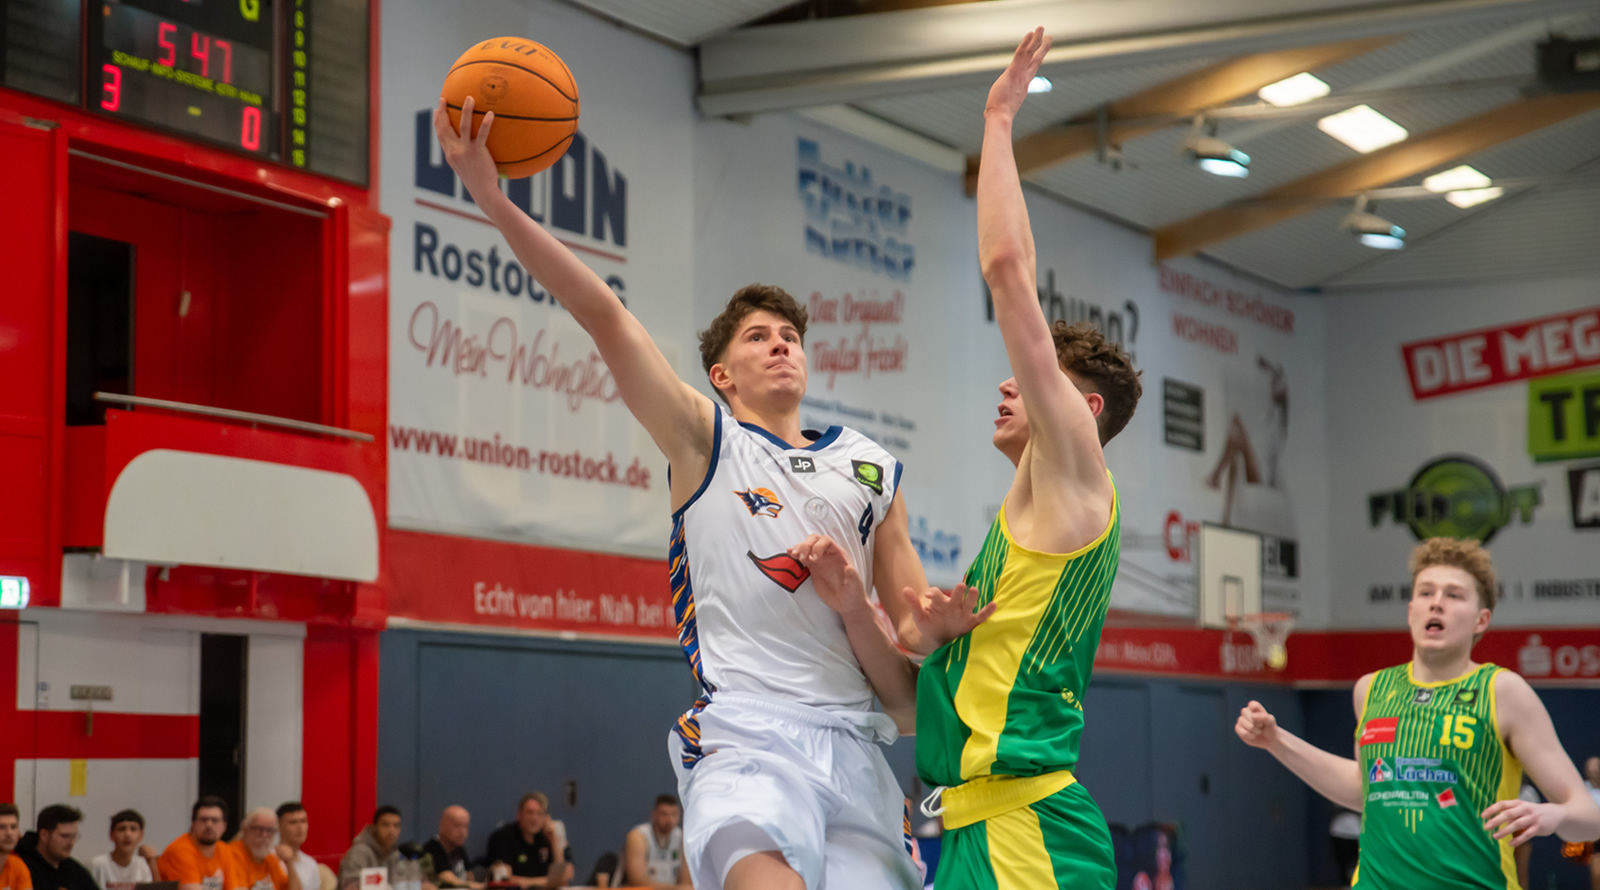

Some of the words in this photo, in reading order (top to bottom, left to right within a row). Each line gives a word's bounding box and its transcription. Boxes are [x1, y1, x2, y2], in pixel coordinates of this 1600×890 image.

[158, 22, 177, 67] 5
[191, 33, 232, 84] 47
[101, 63, 122, 112] 3
[241, 106, 261, 151] 0
[408, 301, 487, 378] Mein
[1412, 335, 1491, 392] DIE
[389, 424, 651, 490] www.union-rostock.de
[474, 581, 516, 616] Echt
[517, 594, 554, 619] von
[556, 589, 597, 622] hier.
[600, 594, 635, 624] Nah
[638, 597, 661, 626] bei
[1440, 714, 1477, 749] 15
